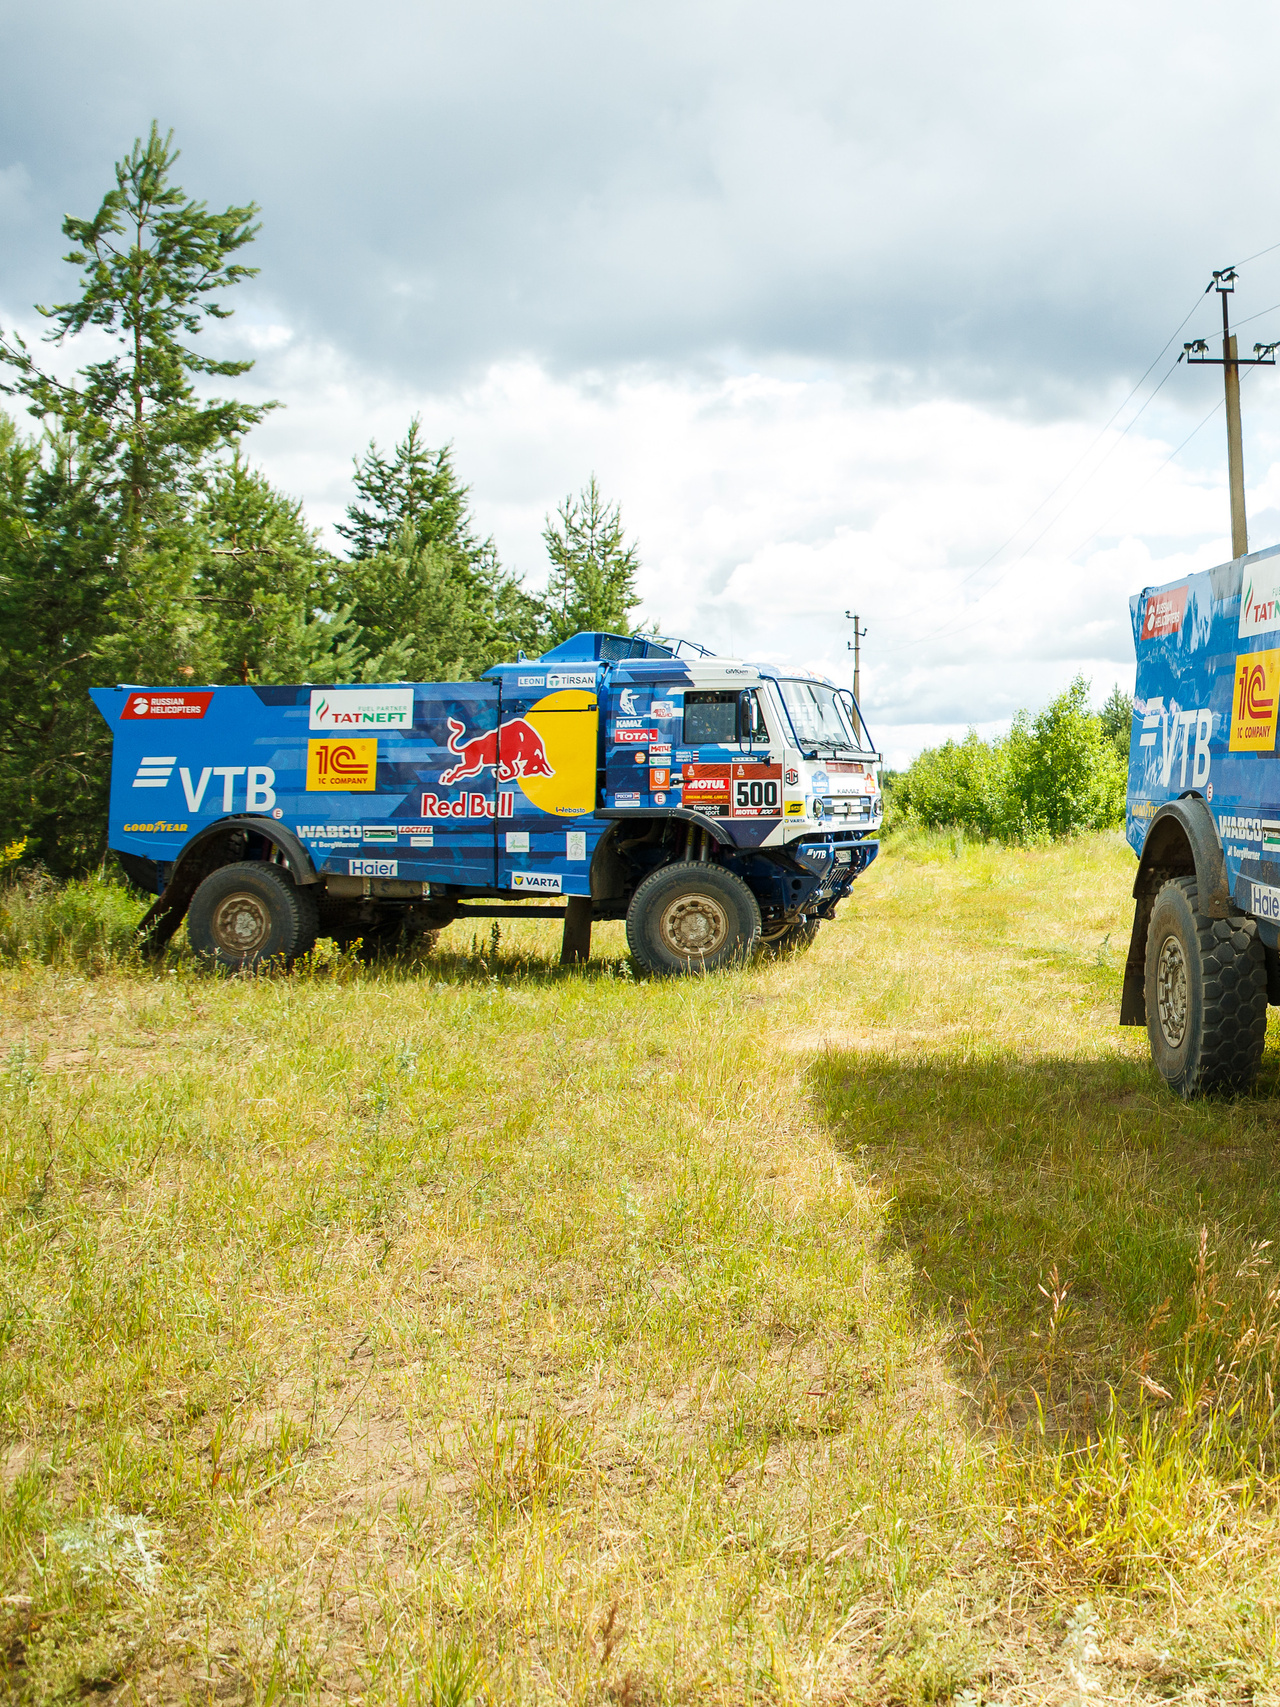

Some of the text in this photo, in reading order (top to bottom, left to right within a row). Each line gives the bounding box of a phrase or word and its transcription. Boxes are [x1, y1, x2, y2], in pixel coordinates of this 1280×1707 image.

[151, 698, 184, 706] RUSSIAN
[150, 706, 202, 714] HELICOPTERS
[332, 713, 407, 723] TATNEFT
[616, 719, 643, 728] KAMAZ
[617, 731, 657, 741] TOTAL
[1244, 726, 1271, 739] COMPANY
[1162, 708, 1212, 788] VTB
[179, 767, 276, 813] VTB
[688, 780, 726, 789] MOTUL
[736, 782, 777, 807] 500
[421, 792, 515, 818] Red Bull
[123, 821, 189, 834] GOODYEAR
[296, 826, 362, 838] WABCO
[1218, 815, 1262, 842] WABCO
[318, 841, 360, 849] BorgWarner
[812, 850, 827, 859] VTB
[352, 861, 394, 875] Haier
[526, 877, 560, 888] VARTA
